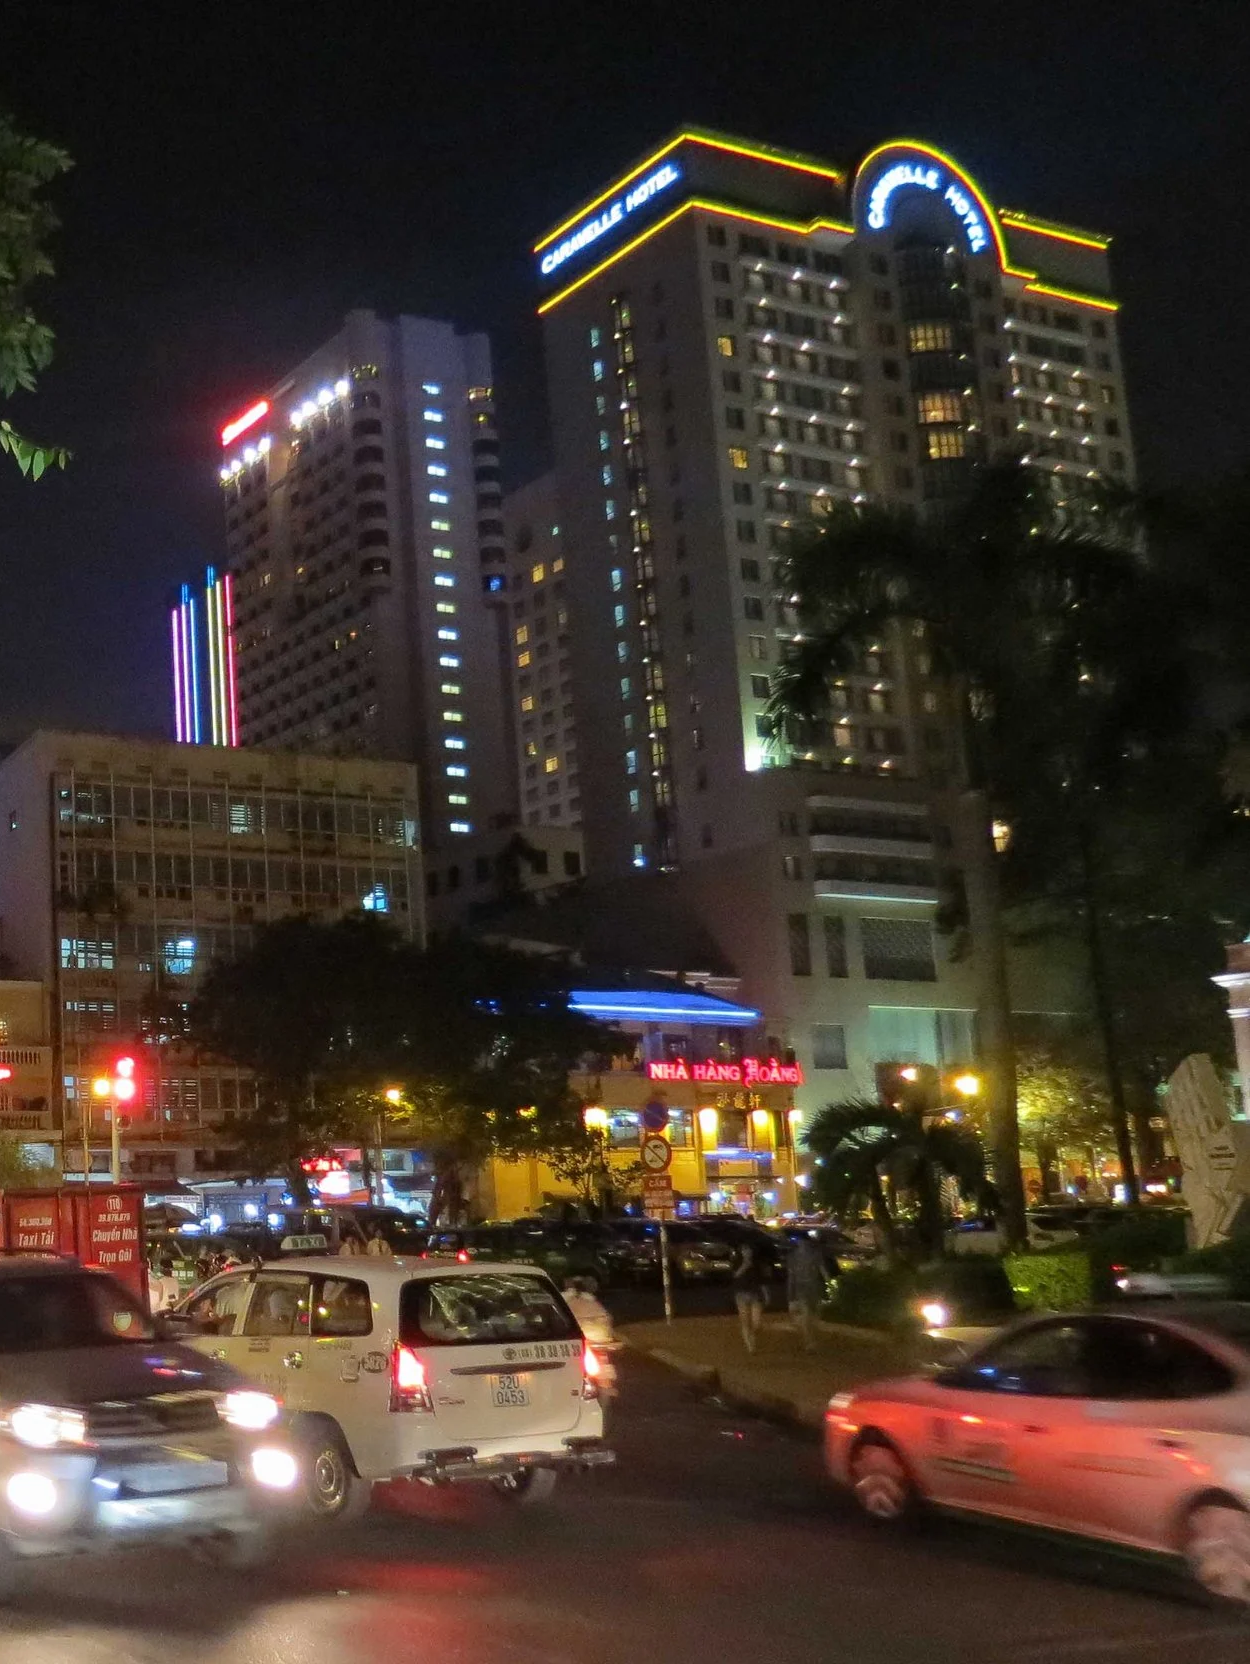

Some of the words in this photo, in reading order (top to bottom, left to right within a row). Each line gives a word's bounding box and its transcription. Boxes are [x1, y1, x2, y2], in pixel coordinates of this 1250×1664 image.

[868, 164, 939, 229] CARAVELLE
[944, 184, 986, 253] HOTEL
[541, 202, 623, 274] CARAVELLE
[625, 165, 678, 213] HOTEL
[649, 1058, 689, 1080] NHÀ
[693, 1058, 741, 1080] HÀNG
[18, 1232, 38, 1247] Taxi
[498, 1375, 520, 1390] 52U
[496, 1391, 525, 1405] 0453
